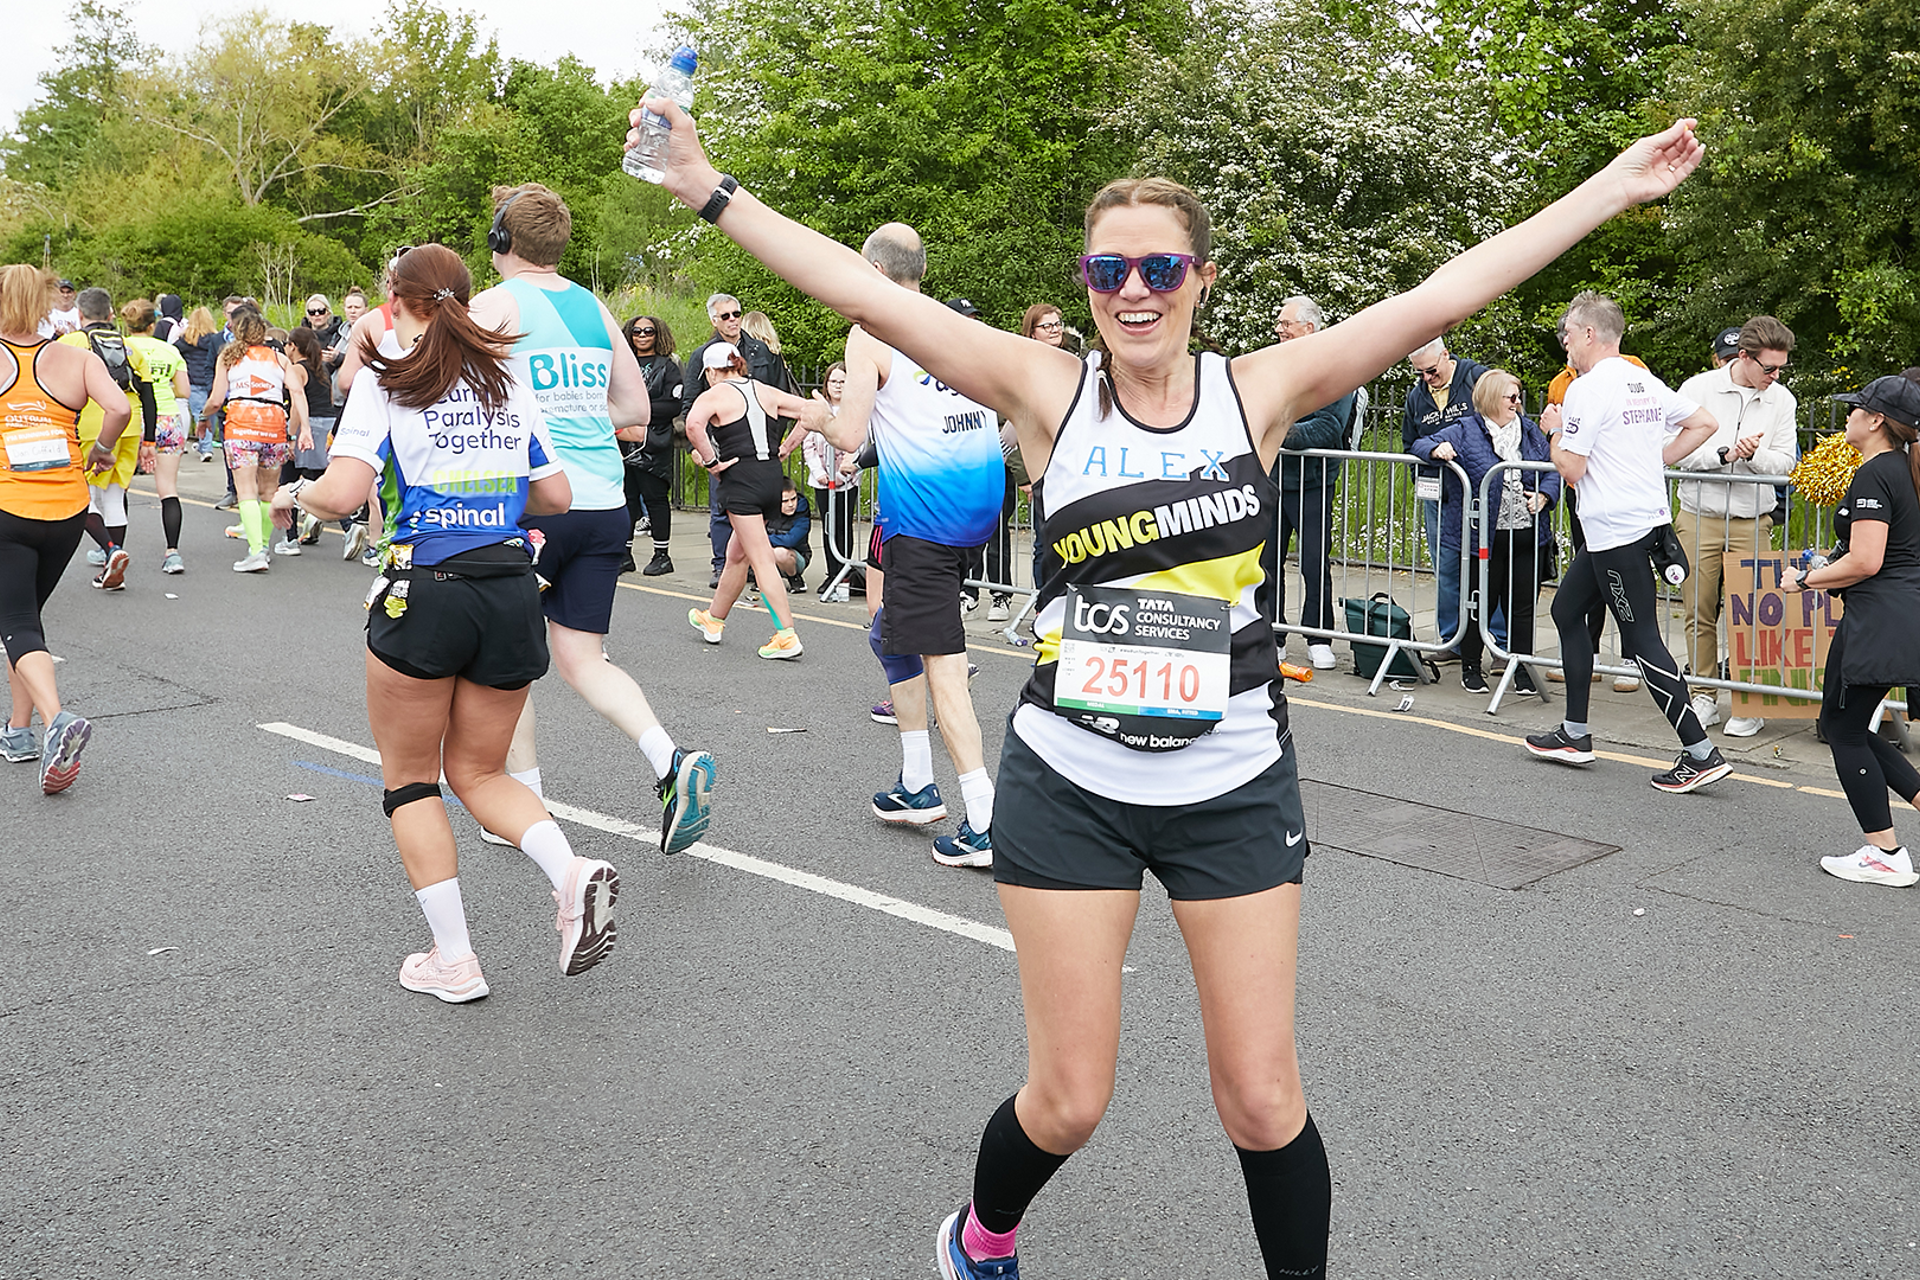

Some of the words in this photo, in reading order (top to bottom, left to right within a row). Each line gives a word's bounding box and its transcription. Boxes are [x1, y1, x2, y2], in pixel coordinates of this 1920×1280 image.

[529, 352, 607, 391] Bliss
[235, 380, 250, 390] MS
[535, 393, 550, 403] for
[553, 390, 583, 401] babies
[586, 390, 604, 400] born
[423, 406, 520, 431] Paralysis
[942, 410, 987, 434] JOHNNY
[428, 429, 521, 454] Together
[1082, 446, 1228, 479] ALEX
[432, 470, 518, 493] CHELSEA
[424, 502, 505, 529] spinal
[1052, 484, 1261, 569] YOUNGMINDS
[1073, 594, 1131, 635] tcs
[1137, 598, 1175, 612] TATA
[1731, 592, 1783, 627] NO
[1134, 624, 1191, 641] SERVICES
[1135, 611, 1222, 631] CONSULTANCY
[1736, 629, 1818, 668] LIKE
[1081, 656, 1200, 703] 25110
[1739, 667, 1825, 706] FINIS
[1119, 732, 1148, 747] new
